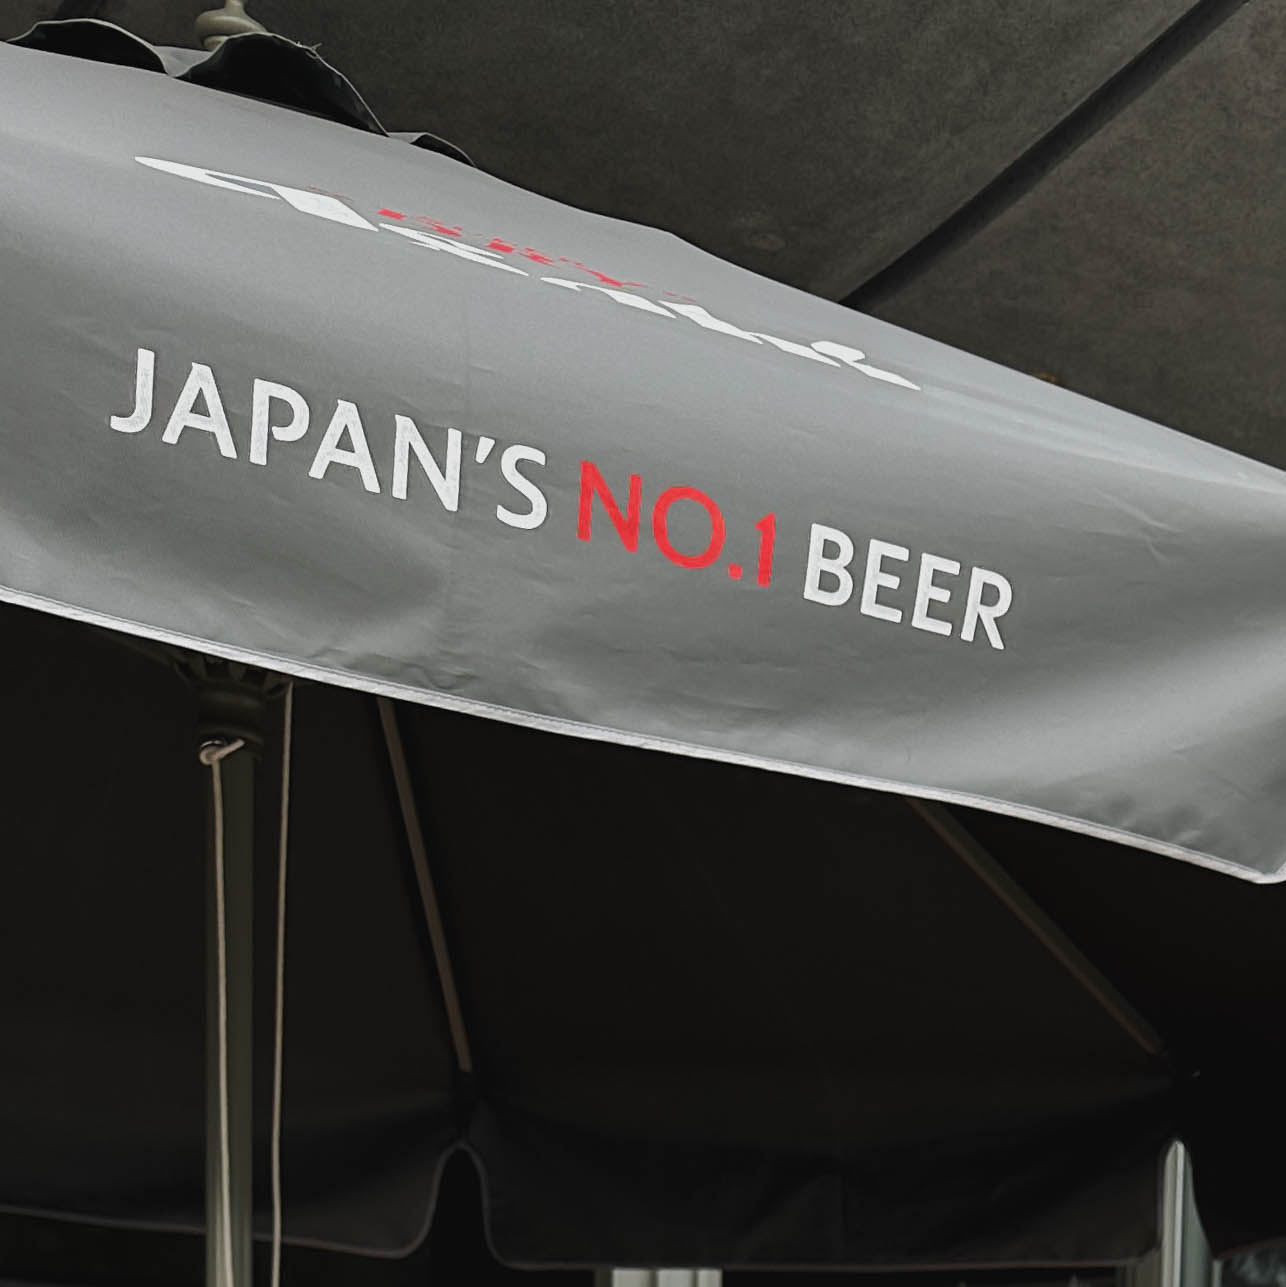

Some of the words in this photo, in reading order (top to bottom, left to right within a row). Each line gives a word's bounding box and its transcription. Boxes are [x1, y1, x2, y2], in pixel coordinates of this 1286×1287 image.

[109, 347, 549, 531] JAPAN'S
[576, 459, 778, 588] NO.1
[802, 521, 1015, 650] BEER
